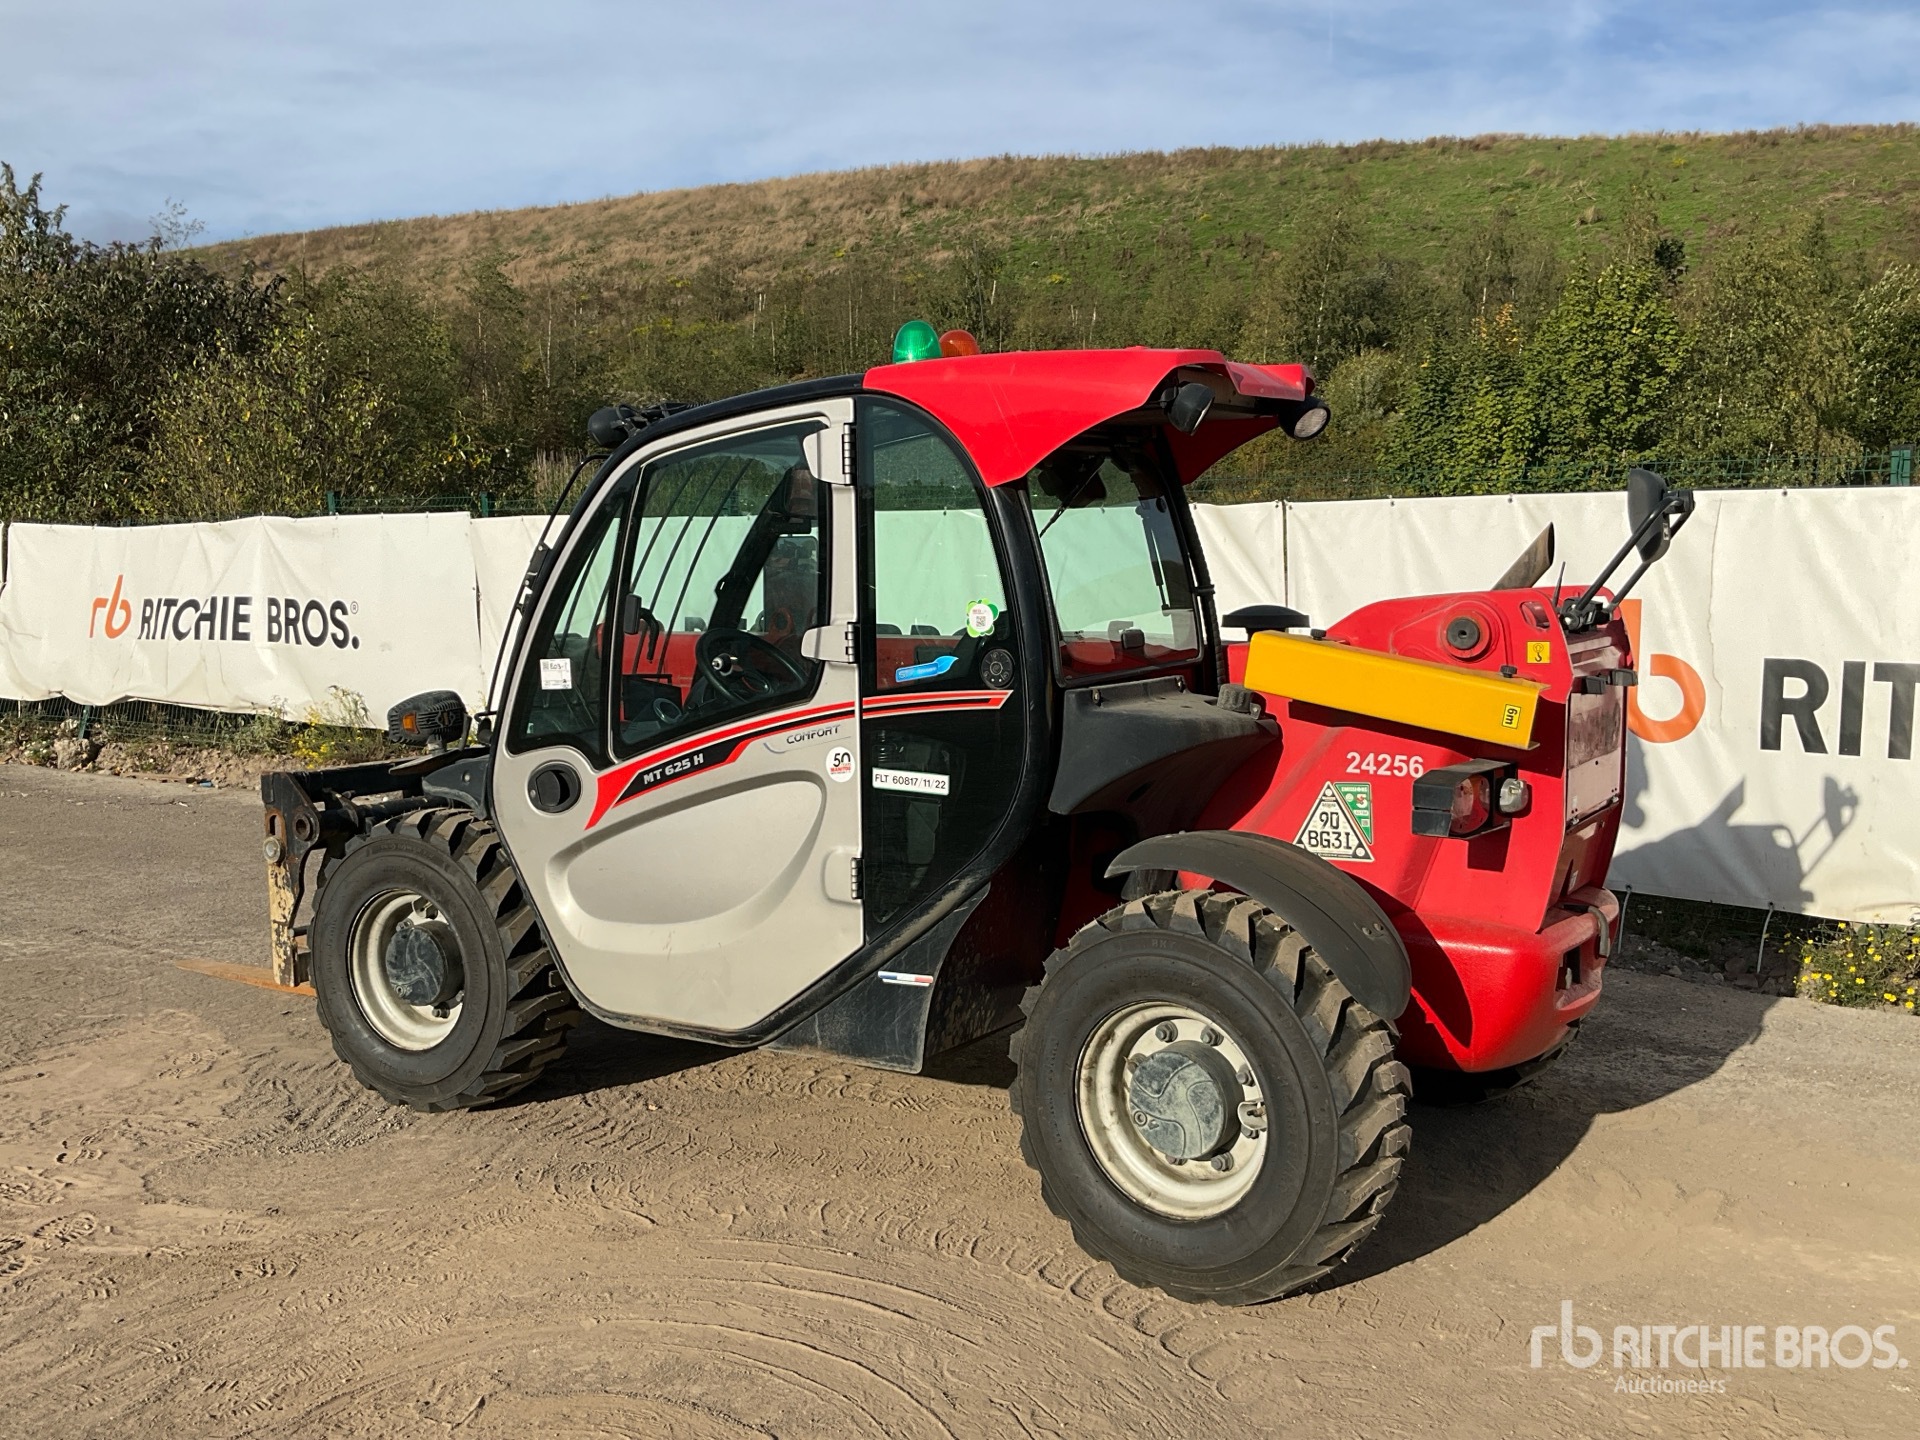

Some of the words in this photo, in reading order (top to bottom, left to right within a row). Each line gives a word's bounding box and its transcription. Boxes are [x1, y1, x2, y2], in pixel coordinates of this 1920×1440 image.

[137, 595, 253, 641] RITCHIE
[1505, 708, 1518, 725] 6m
[1760, 657, 1920, 760] RIT
[786, 724, 841, 744] COMFORT
[643, 768, 663, 785] MT
[665, 760, 691, 775] 625
[693, 753, 704, 766] H
[833, 752, 851, 767] 50
[1345, 751, 1424, 779] 24256
[875, 774, 889, 783] FLT
